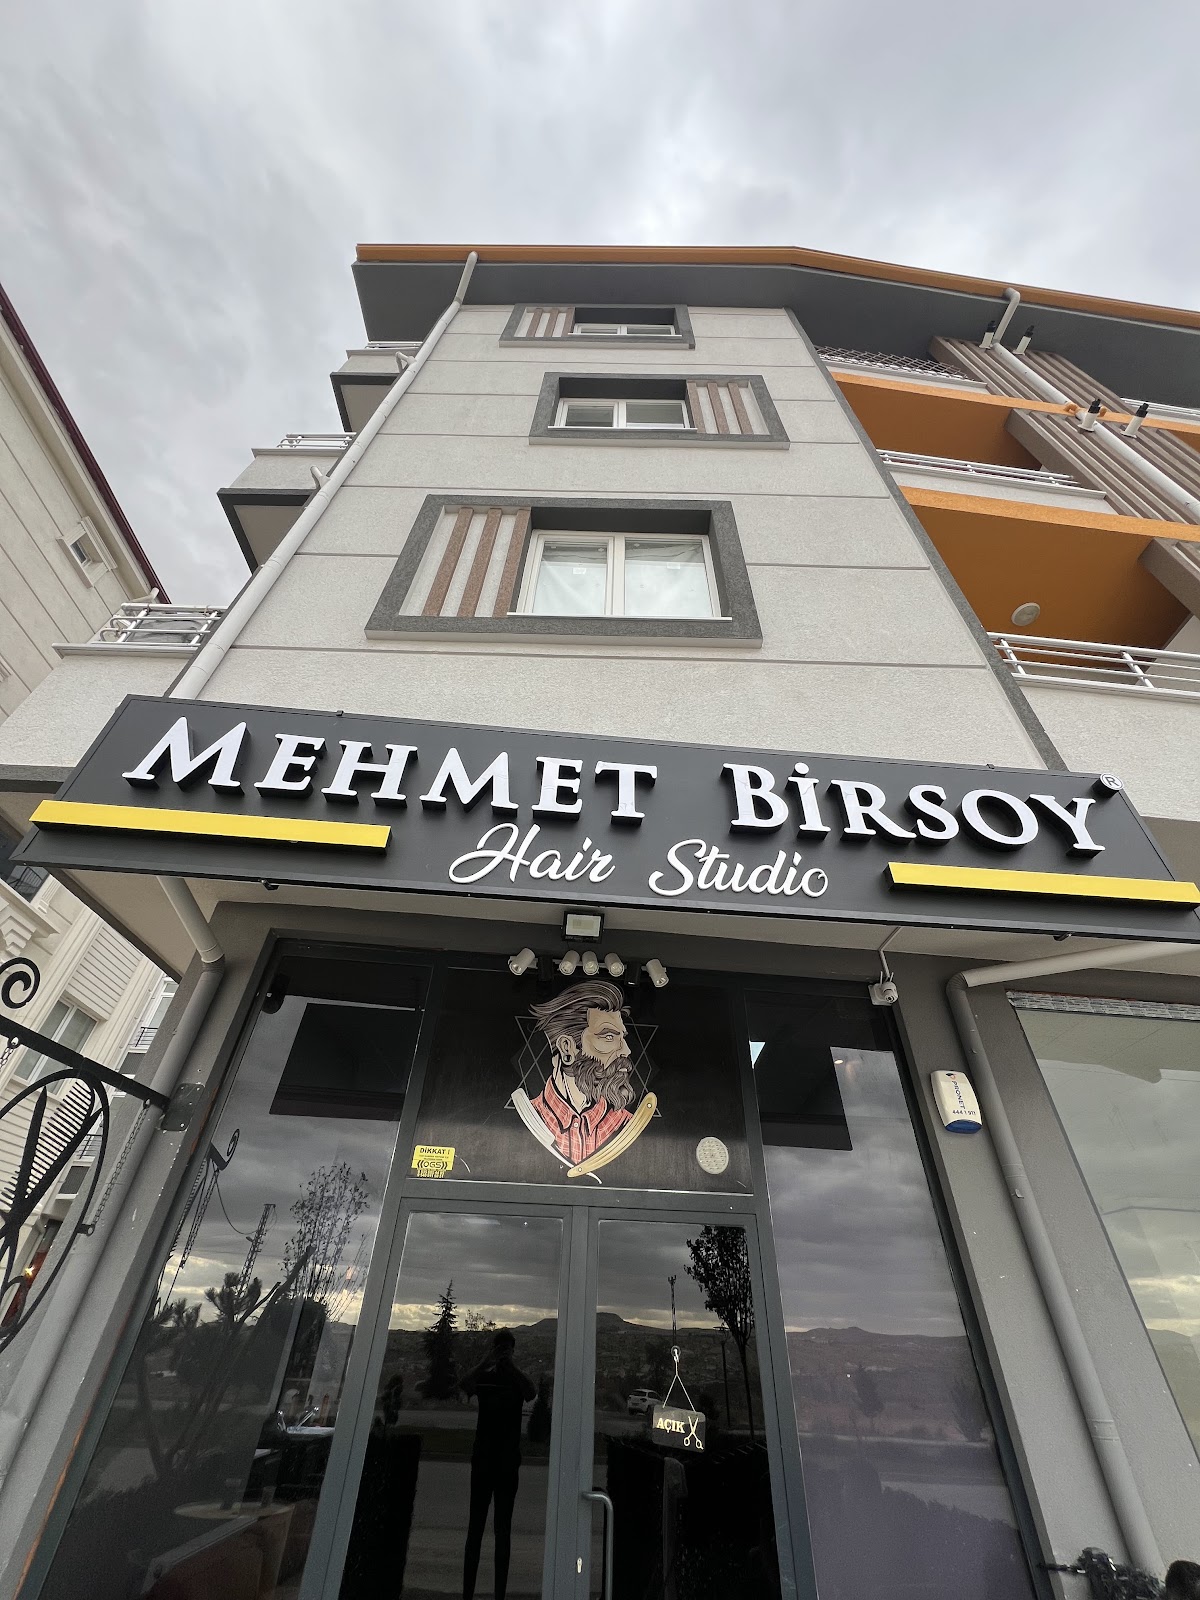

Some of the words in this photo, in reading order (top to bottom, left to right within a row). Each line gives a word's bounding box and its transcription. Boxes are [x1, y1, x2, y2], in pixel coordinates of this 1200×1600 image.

[122, 716, 658, 820] MEHMET
[449, 822, 615, 884] Hair
[649, 838, 828, 898] Studio
[952, 1080, 965, 1109] PRONET
[656, 1417, 685, 1433] AÇIK
